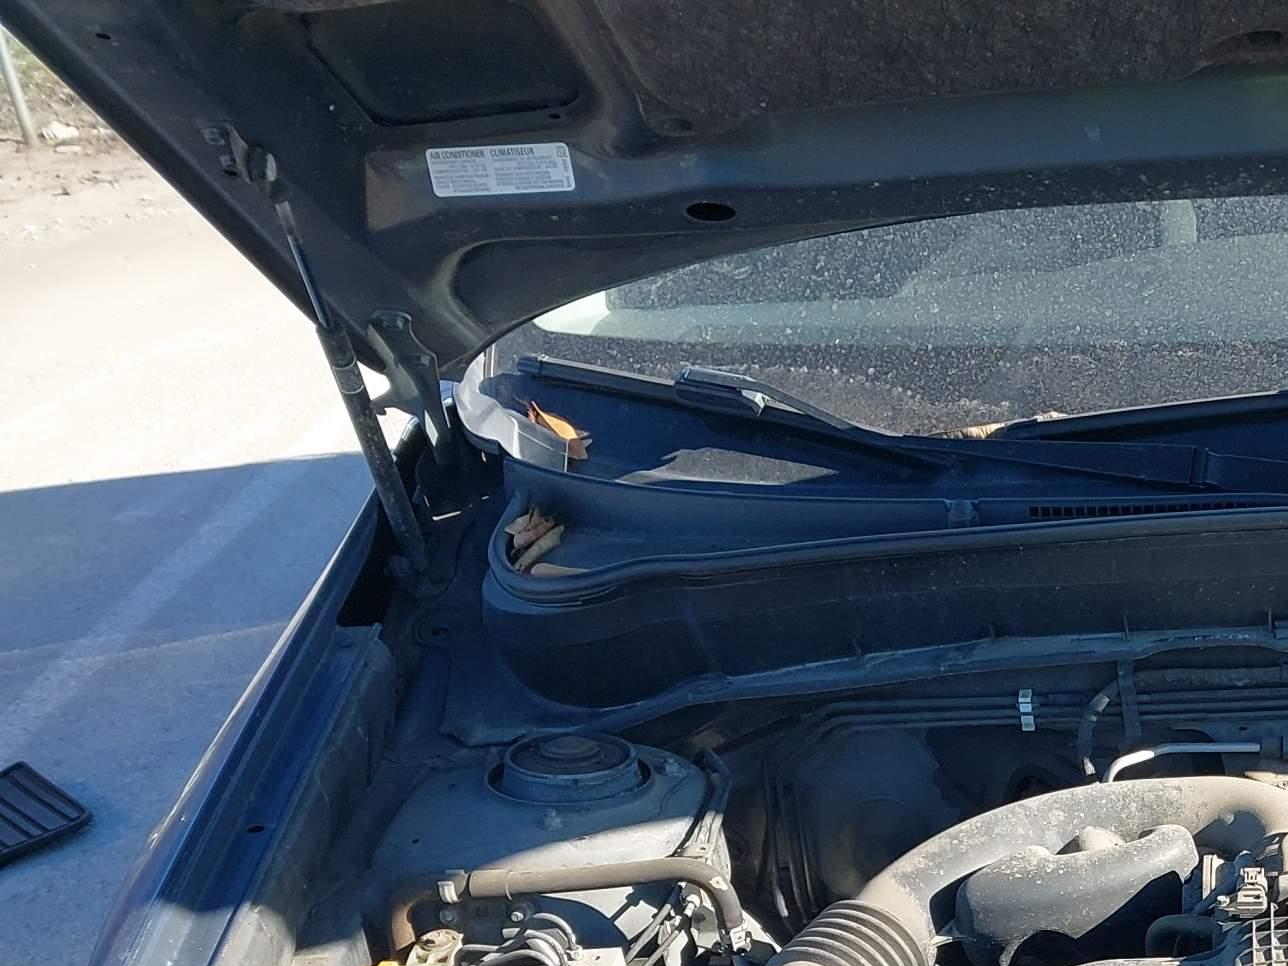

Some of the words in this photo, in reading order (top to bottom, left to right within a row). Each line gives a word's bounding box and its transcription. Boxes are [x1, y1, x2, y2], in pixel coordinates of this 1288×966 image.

[430, 151, 441, 160] AIR
[442, 149, 485, 159] CONDITIONER
[490, 146, 535, 157] CLIMATISEUR
